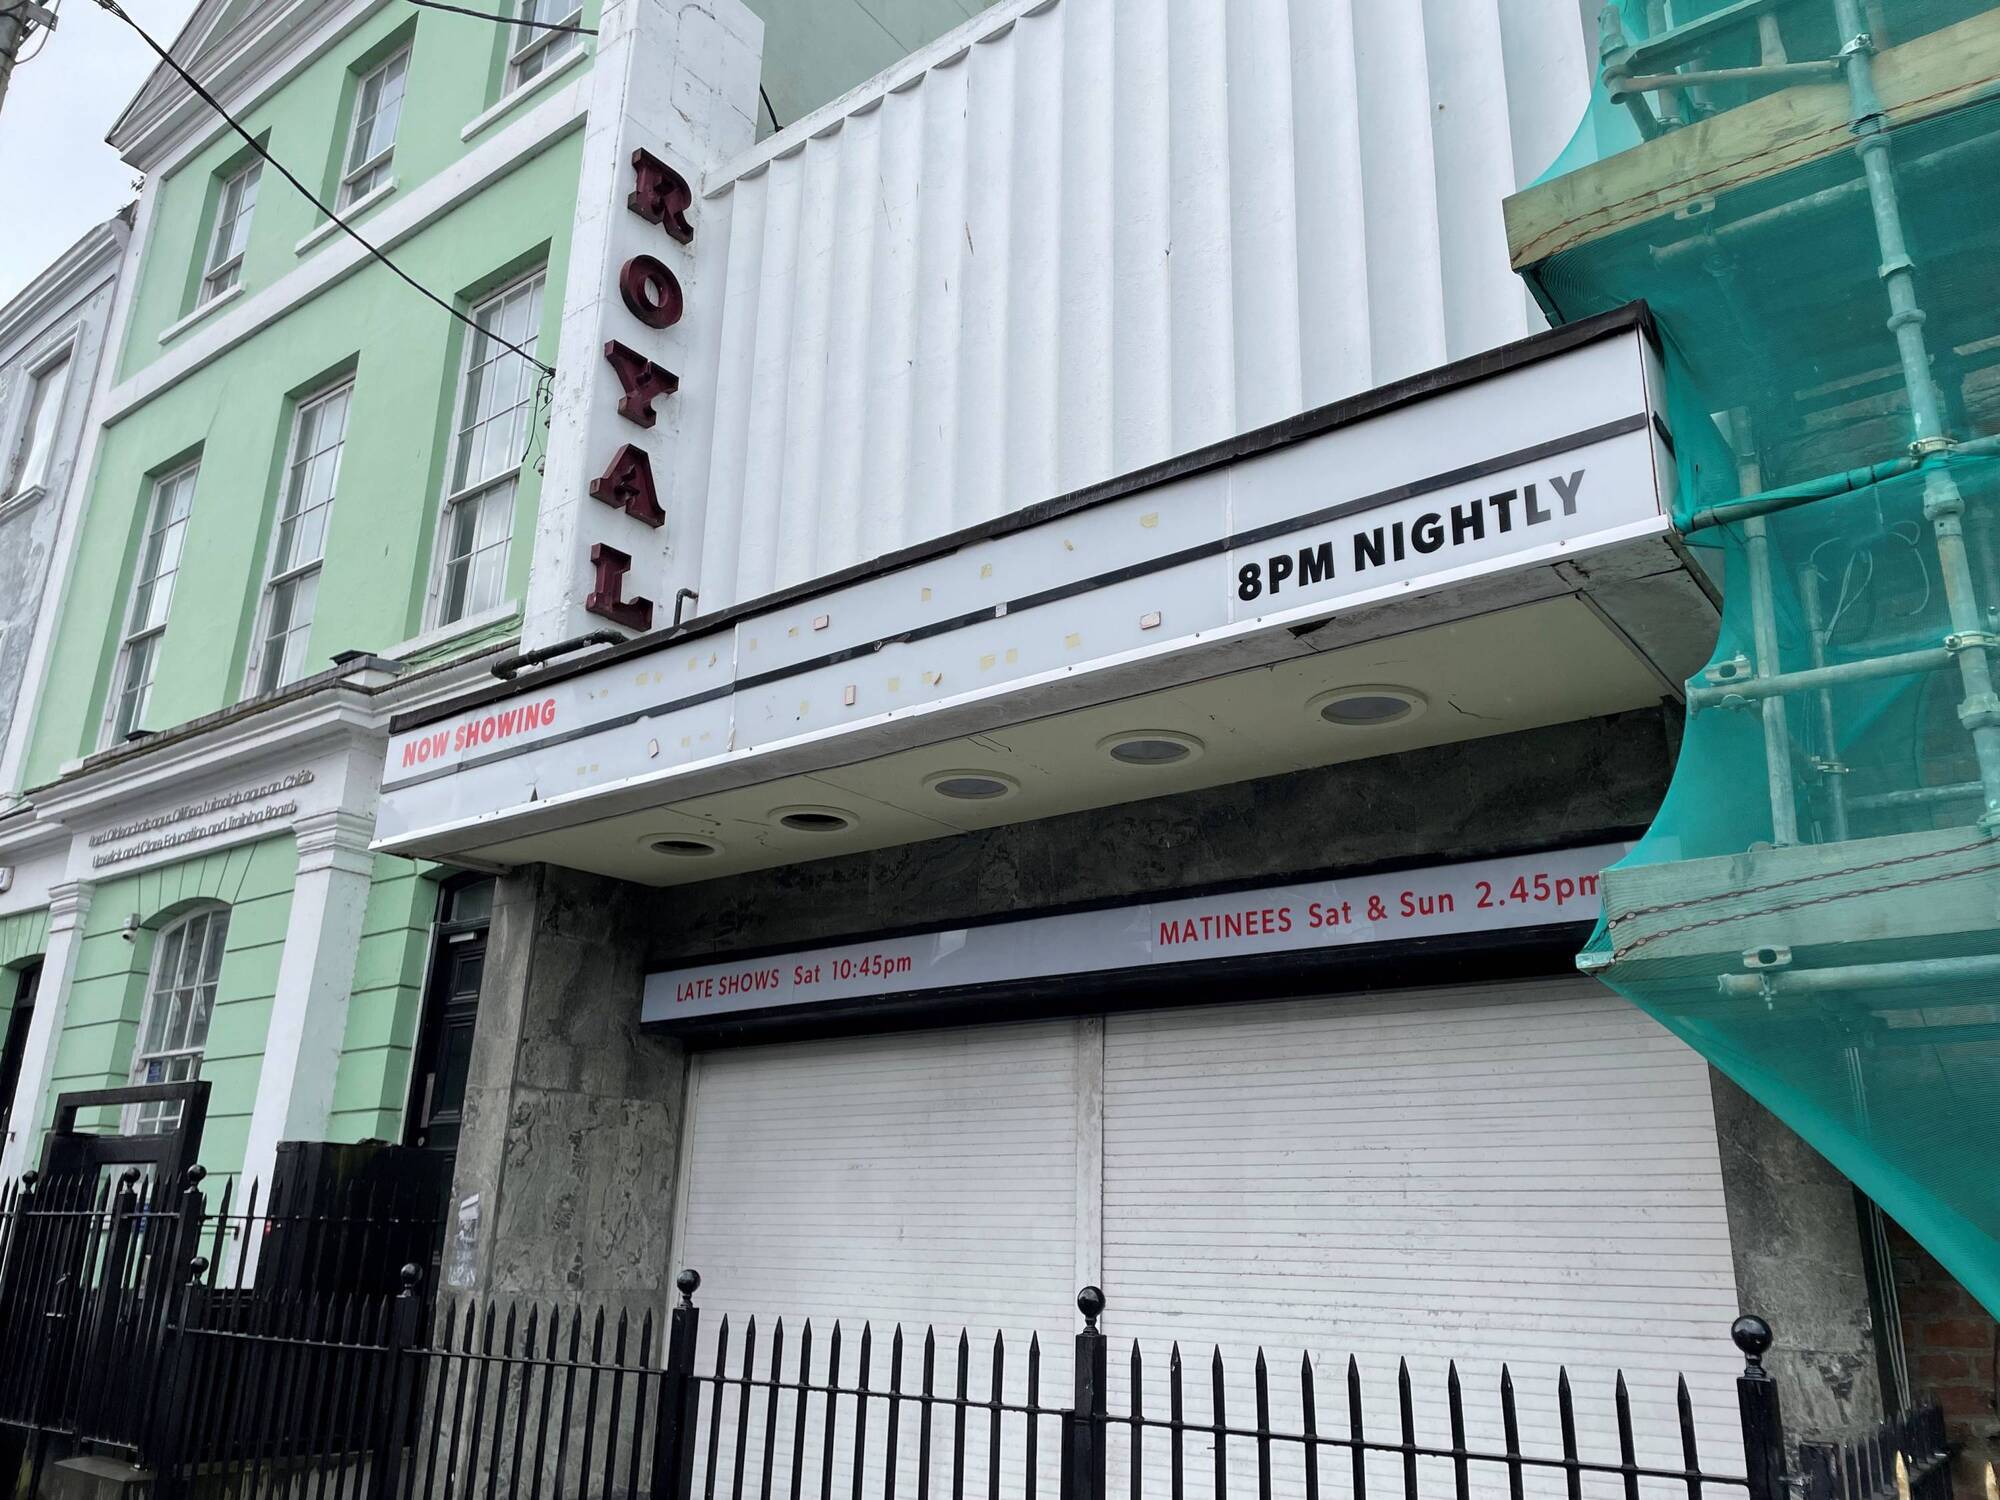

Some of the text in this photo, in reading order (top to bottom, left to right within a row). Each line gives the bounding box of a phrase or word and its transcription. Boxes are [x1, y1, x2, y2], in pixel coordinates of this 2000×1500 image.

[586, 146, 694, 632] ROYAL
[1238, 469, 1585, 601] 8PM NIGHTLY
[402, 698, 556, 768] NOW SHOWING
[122, 842, 140, 859] and
[140, 839, 165, 855] Clare
[164, 825, 207, 848] Education
[208, 817, 228, 834] and
[228, 810, 263, 830] Training
[264, 799, 297, 819] Board
[1159, 872, 1600, 946] MATINEES Sat & Sun 2.45pm
[676, 954, 911, 1002] LATE SHOWS Sat 10:45pm
